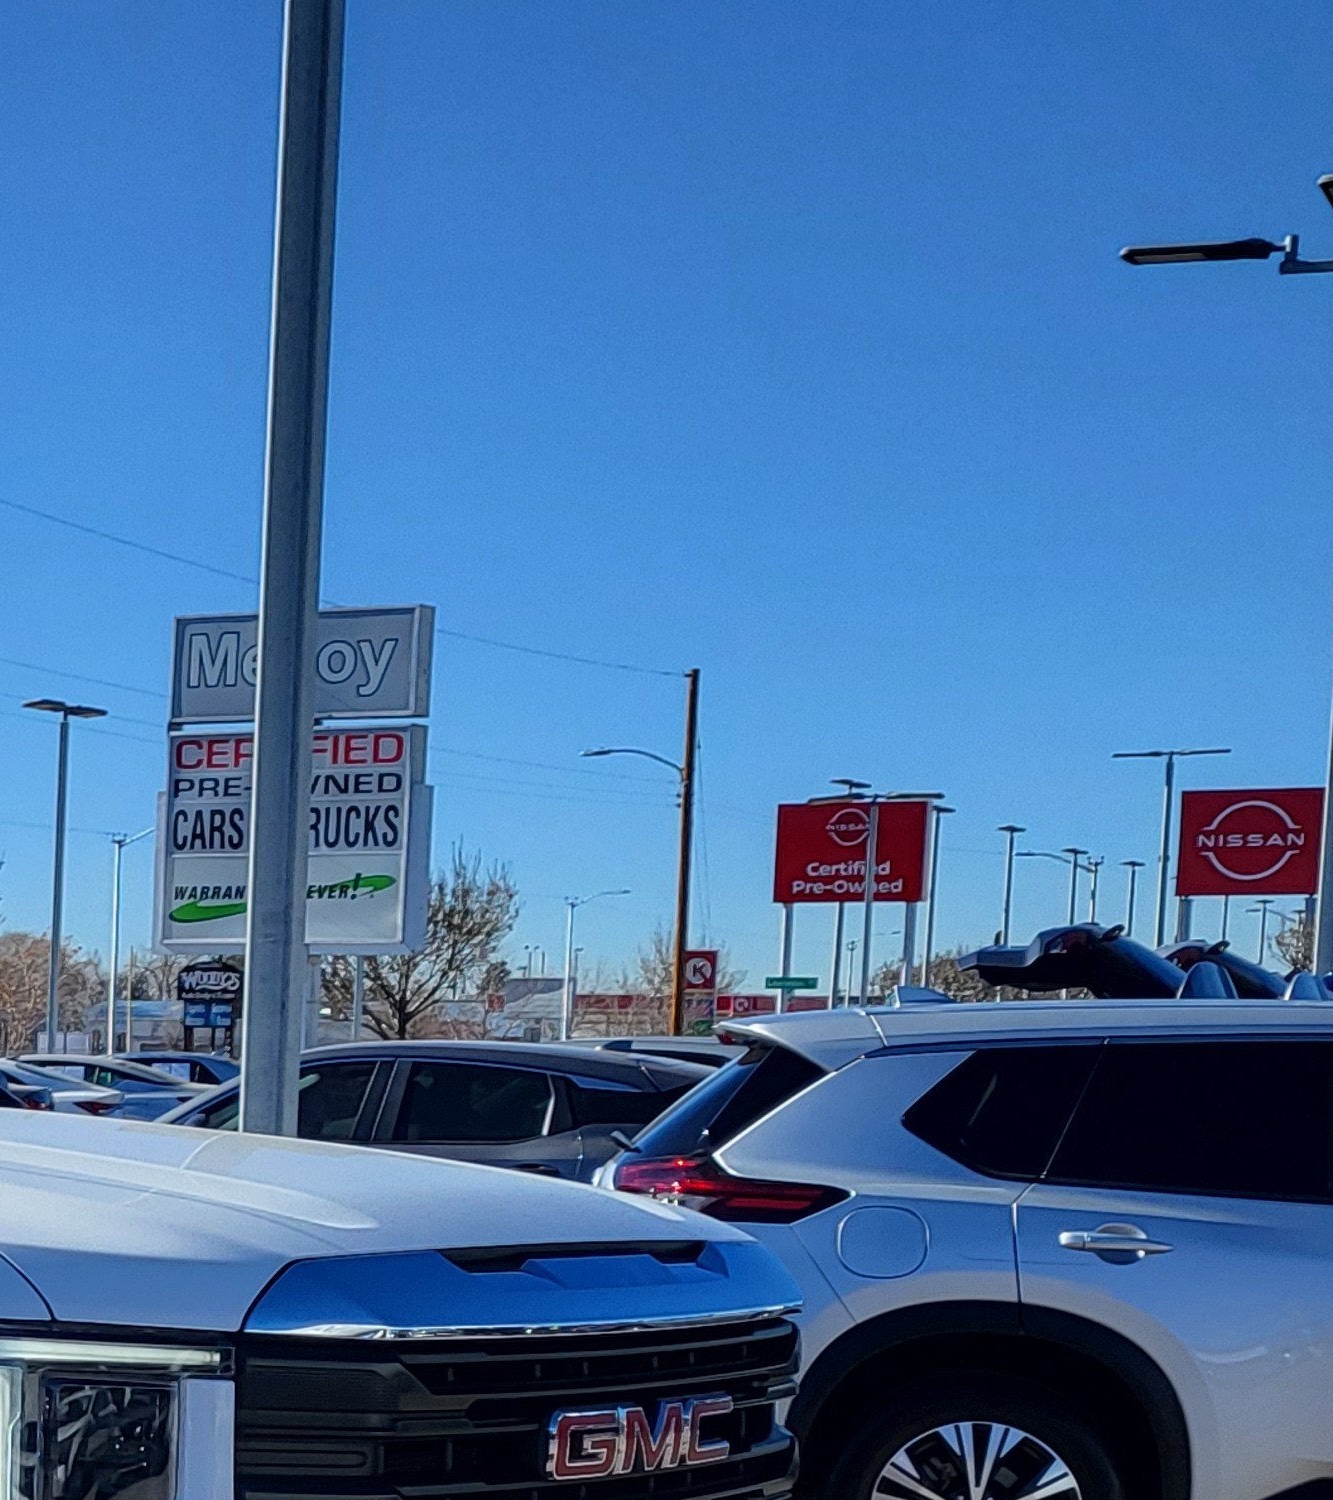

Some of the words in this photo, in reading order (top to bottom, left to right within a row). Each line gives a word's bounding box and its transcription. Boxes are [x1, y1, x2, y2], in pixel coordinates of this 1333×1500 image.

[187, 631, 399, 698] Moy
[175, 733, 404, 769] CERFIED
[173, 808, 244, 850] CARS
[310, 805, 399, 848] RUCKS
[826, 823, 870, 832] NISSA
[1196, 833, 1305, 848] NISSAN
[806, 860, 891, 877] Certifid
[174, 885, 247, 901] WARRAN
[306, 873, 362, 900] EVER!
[792, 878, 903, 894] Pre-Owed
[546, 1395, 733, 1480] GMC
